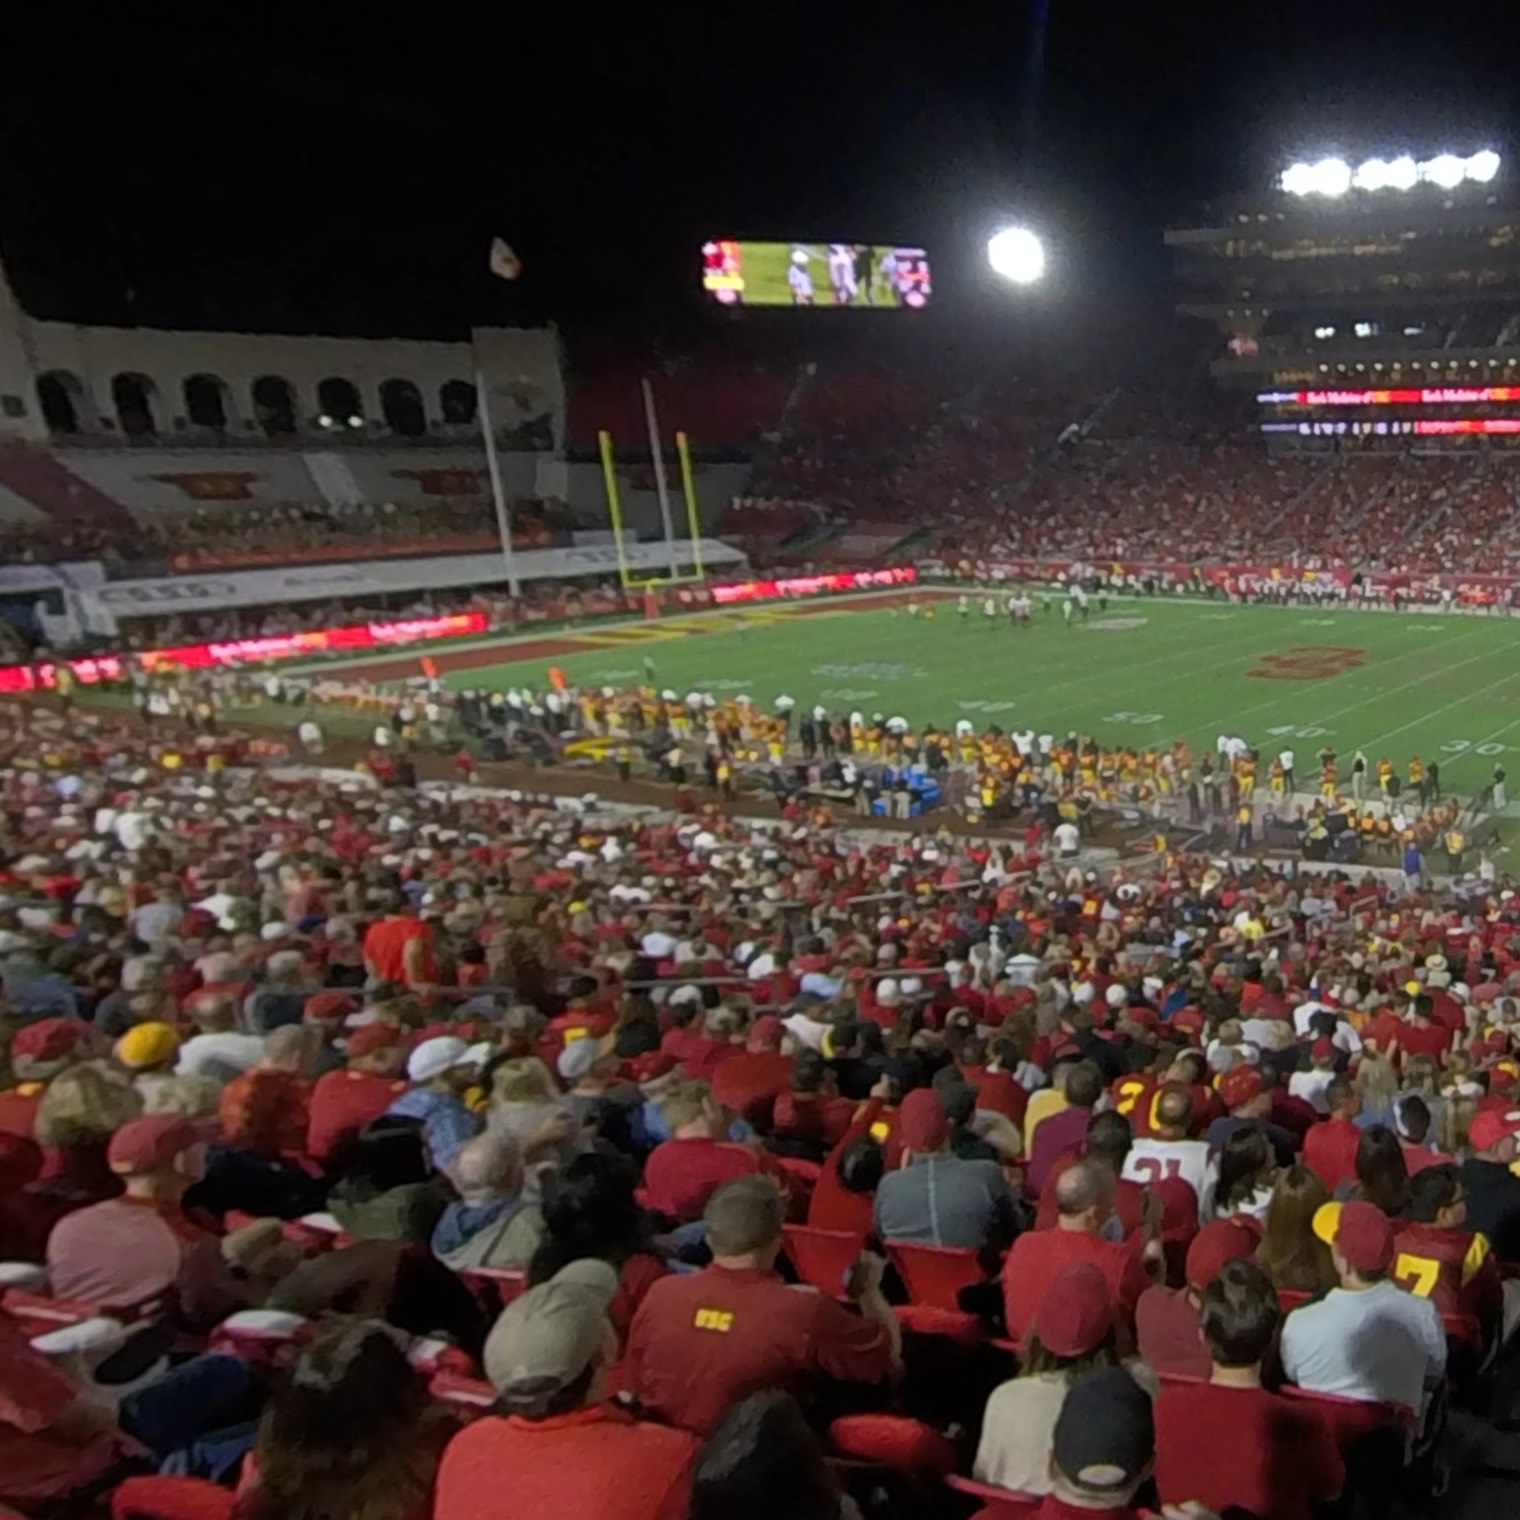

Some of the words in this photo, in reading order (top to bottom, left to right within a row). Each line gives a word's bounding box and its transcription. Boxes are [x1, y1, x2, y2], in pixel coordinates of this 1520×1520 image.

[1440, 739, 1507, 757] 30
[1394, 1252, 1440, 1297] 7
[694, 1308, 733, 1331] USC
